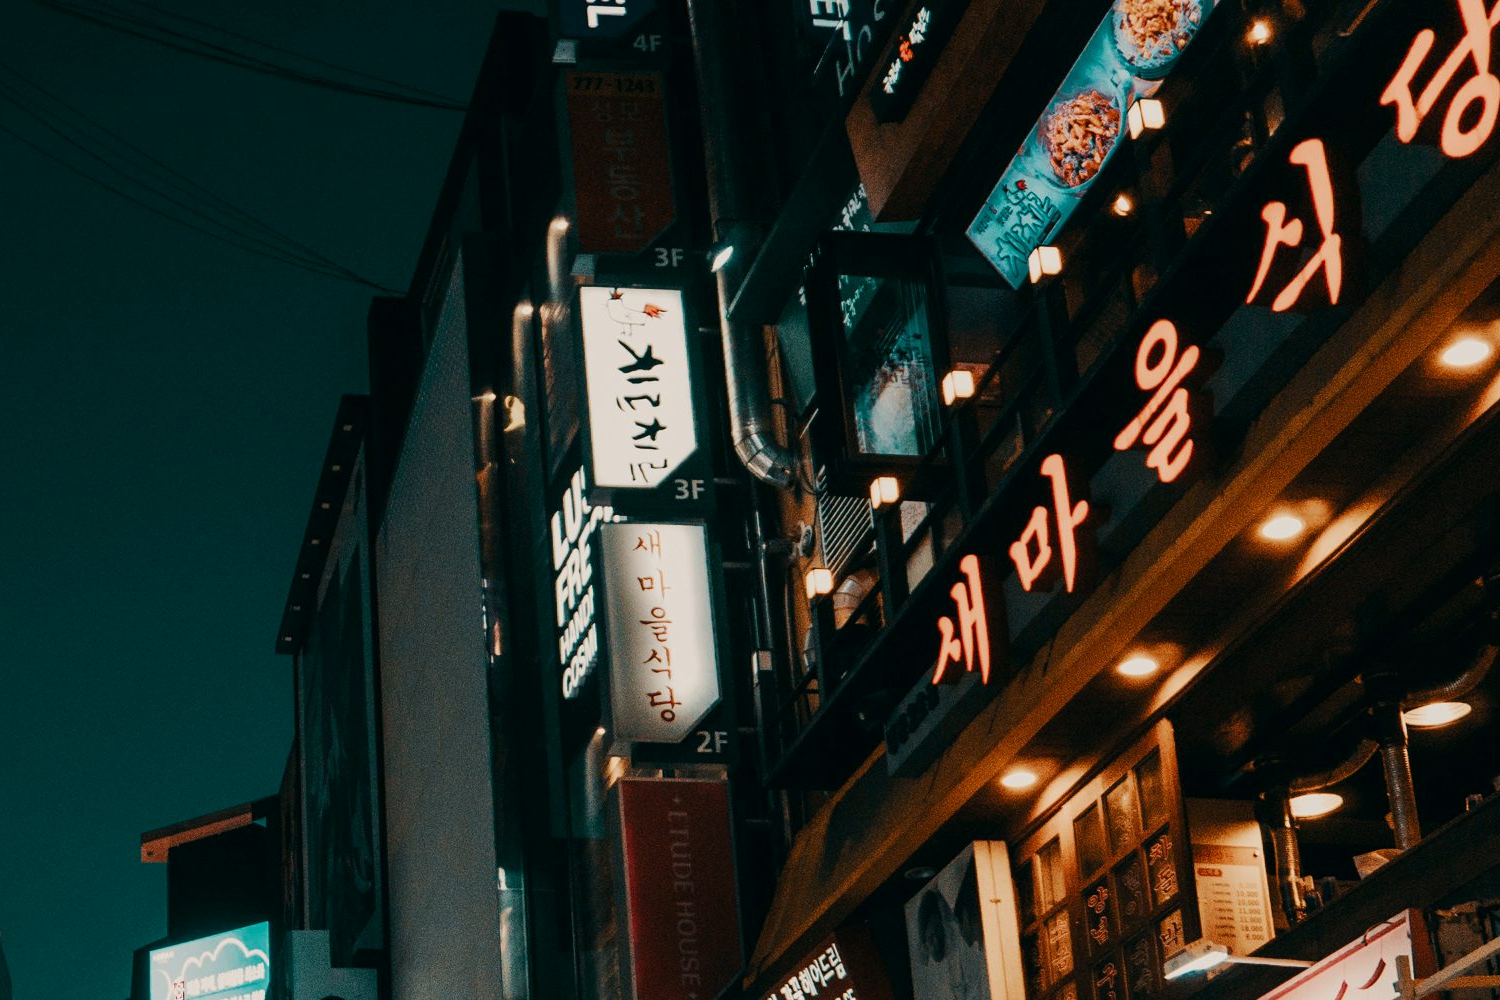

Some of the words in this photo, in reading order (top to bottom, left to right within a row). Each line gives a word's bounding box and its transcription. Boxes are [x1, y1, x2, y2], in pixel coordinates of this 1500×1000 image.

[632, 34, 663, 52] 4F
[654, 248, 684, 268] 3F
[674, 478, 706, 500] 3F
[633, 529, 682, 723] 새마을식당
[696, 731, 729, 753] 2F
[668, 810, 695, 894] ETUDE
[676, 902, 701, 987] HOUSE
